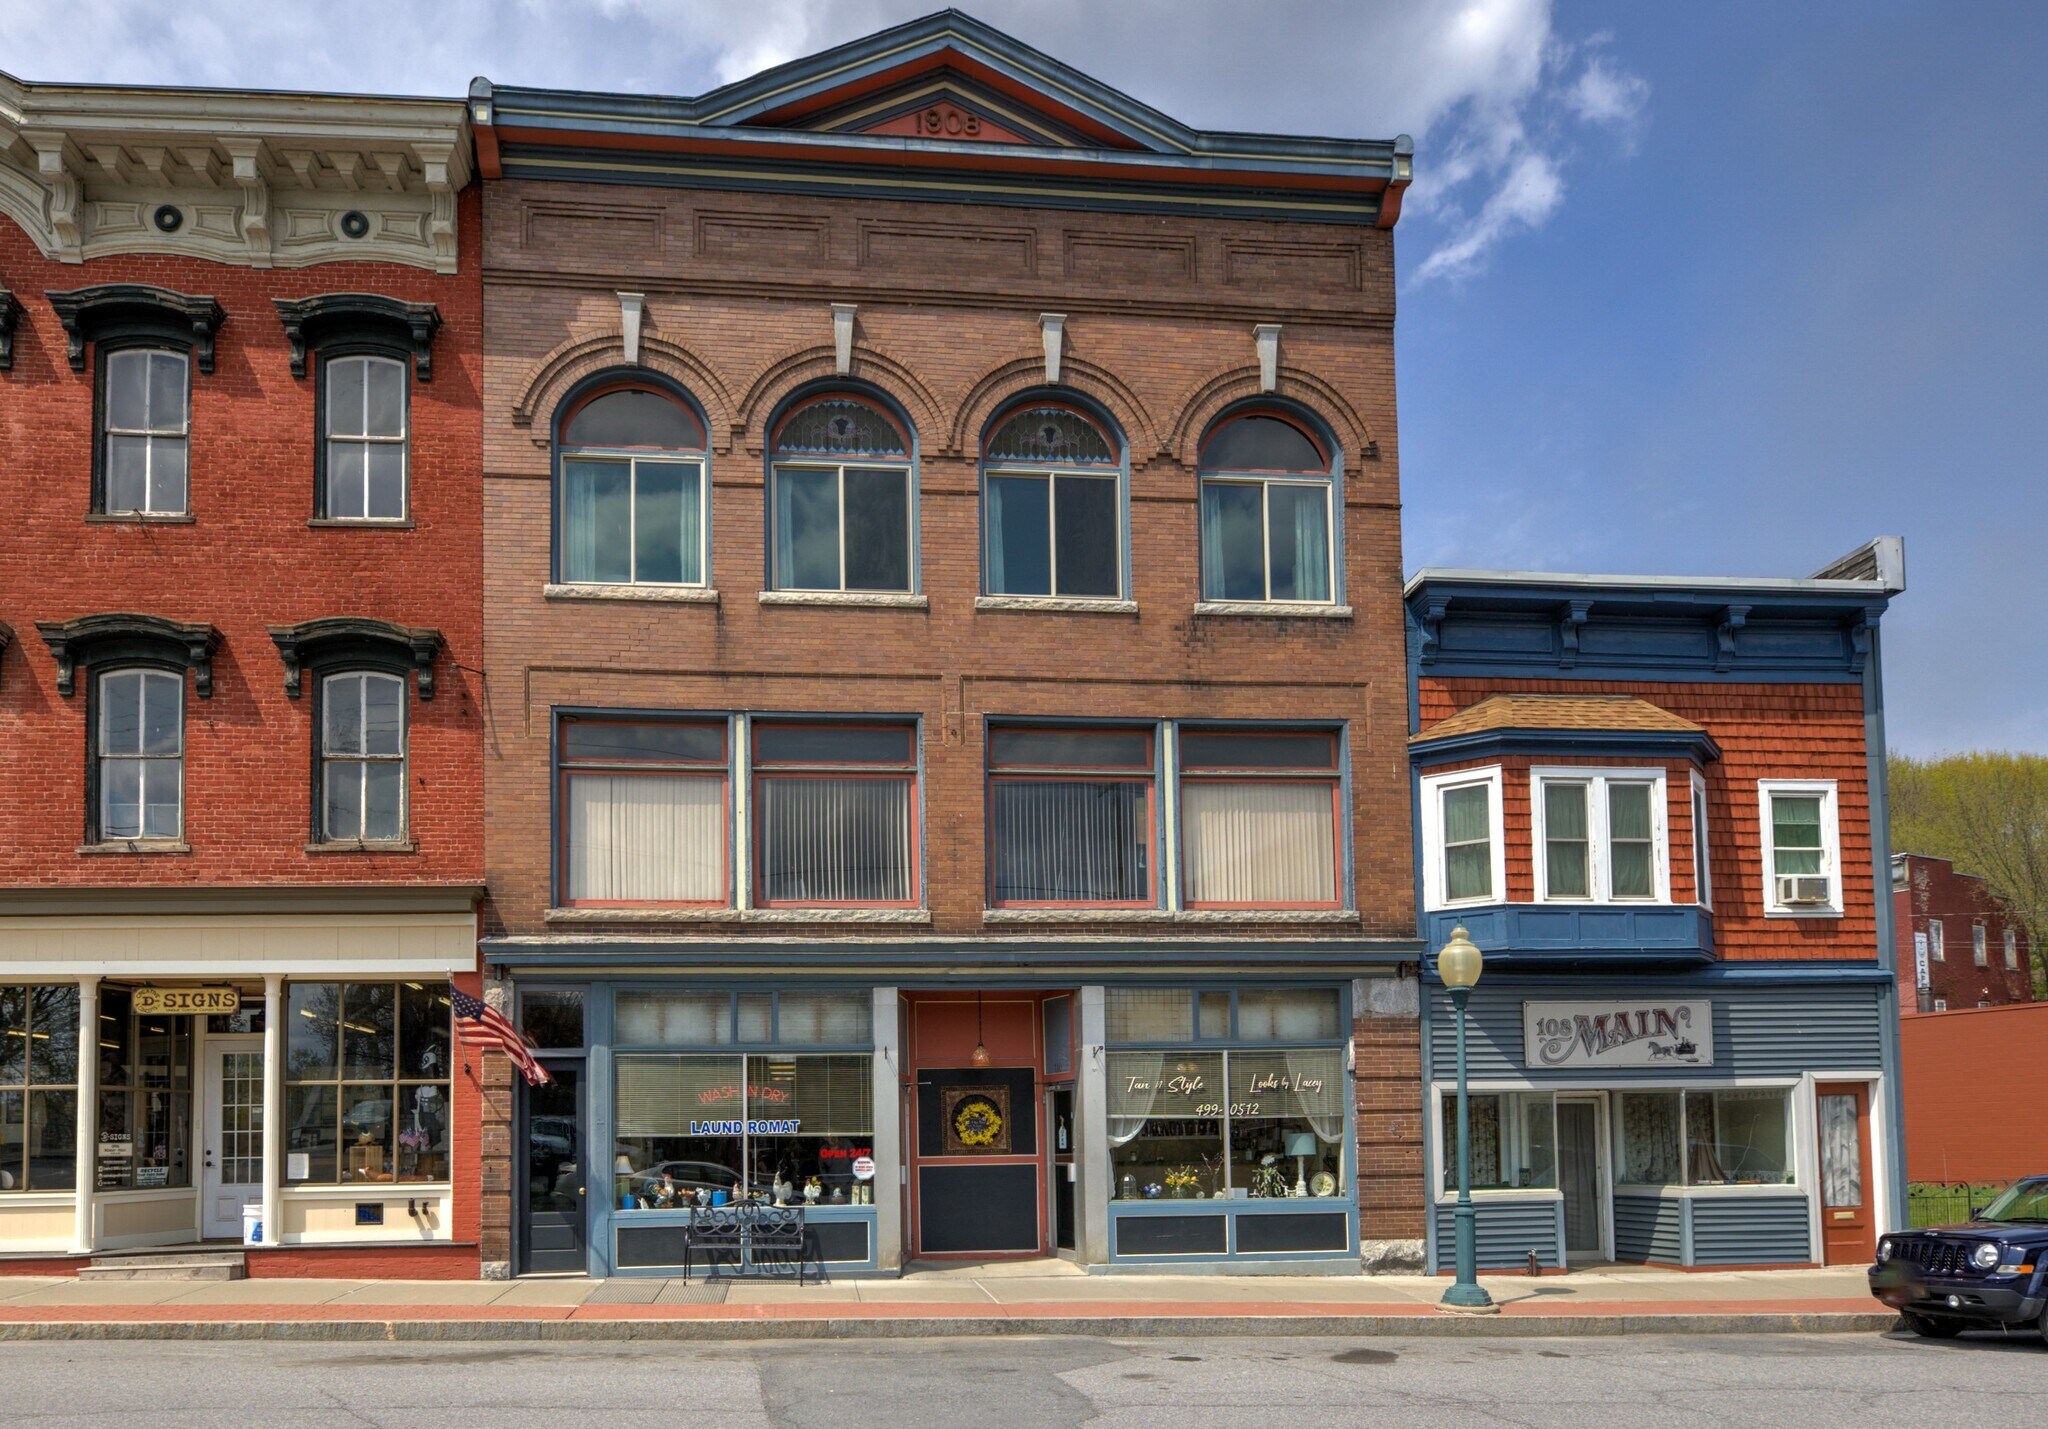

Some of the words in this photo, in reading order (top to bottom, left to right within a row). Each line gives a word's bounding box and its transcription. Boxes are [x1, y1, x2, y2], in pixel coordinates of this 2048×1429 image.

[917, 109, 980, 136] 1908
[1536, 1017, 1573, 1037] 108
[1550, 1006, 1692, 1063] MAIN
[1126, 1076, 1150, 1093] Tan
[1167, 1075, 1204, 1095] Style
[1249, 1073, 1279, 1093] Looks
[1281, 1076, 1290, 1090] by
[1293, 1072, 1323, 1094] Lacey
[698, 1085, 740, 1104] WASH
[761, 1086, 790, 1103] DRY
[1196, 1103, 1260, 1117] 499-0512
[820, 1148, 847, 1159] OPEN
[849, 1147, 872, 1158] 24/7
